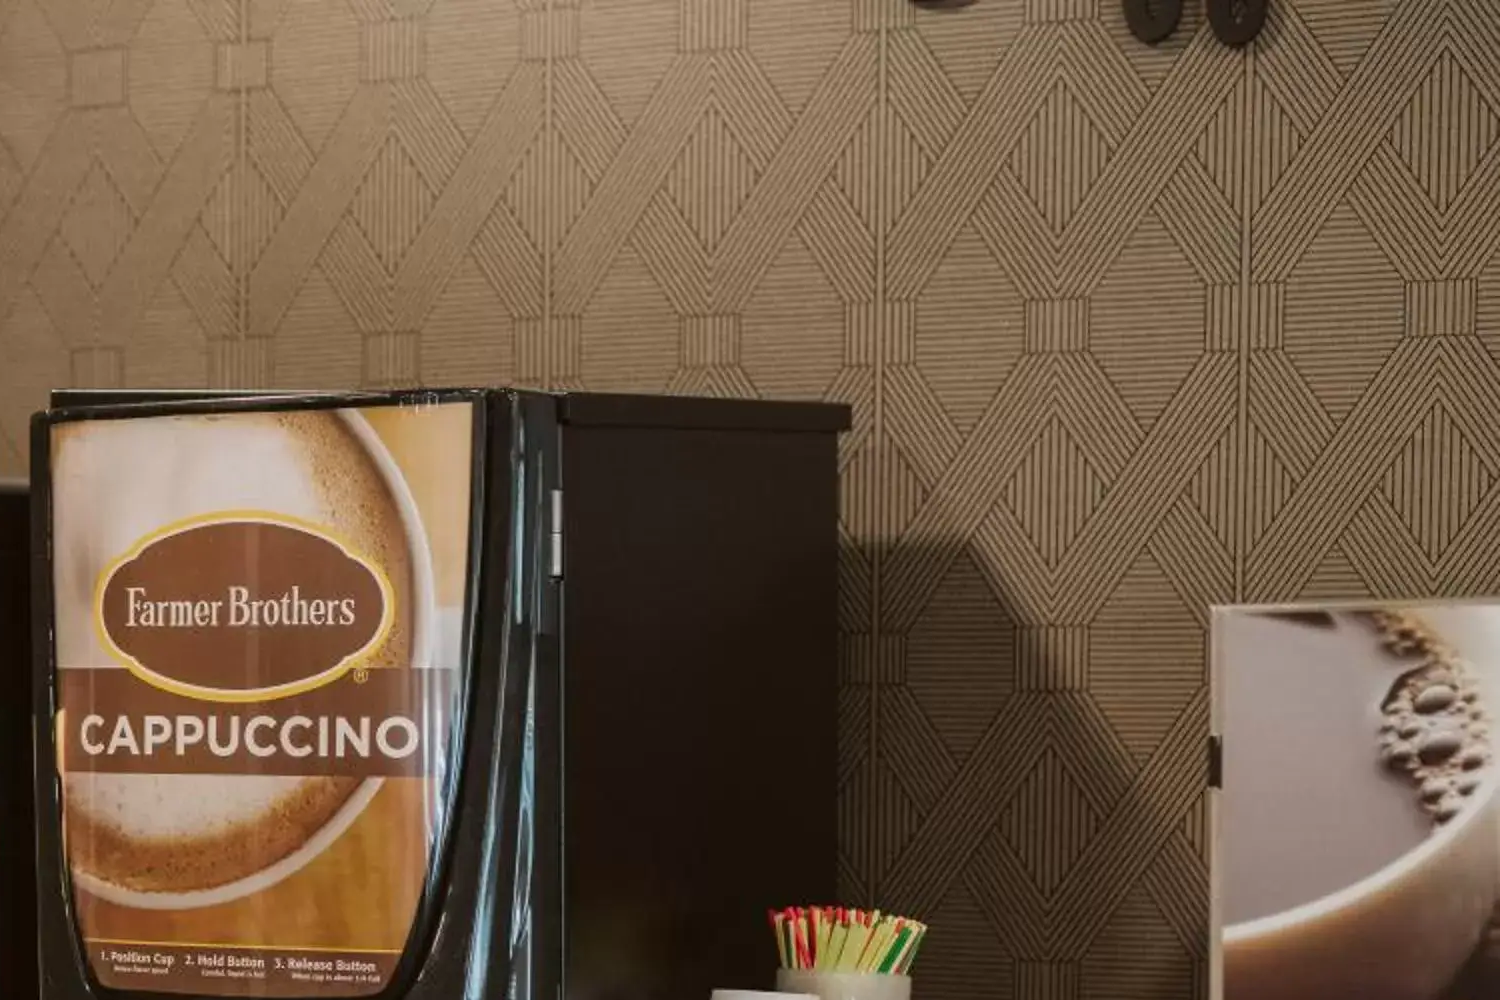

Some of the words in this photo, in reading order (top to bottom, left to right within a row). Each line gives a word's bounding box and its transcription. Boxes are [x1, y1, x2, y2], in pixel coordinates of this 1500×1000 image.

[125, 587, 223, 627] Farmer
[227, 585, 357, 627] Brothers
[80, 714, 420, 759] CAPPUCCINO
